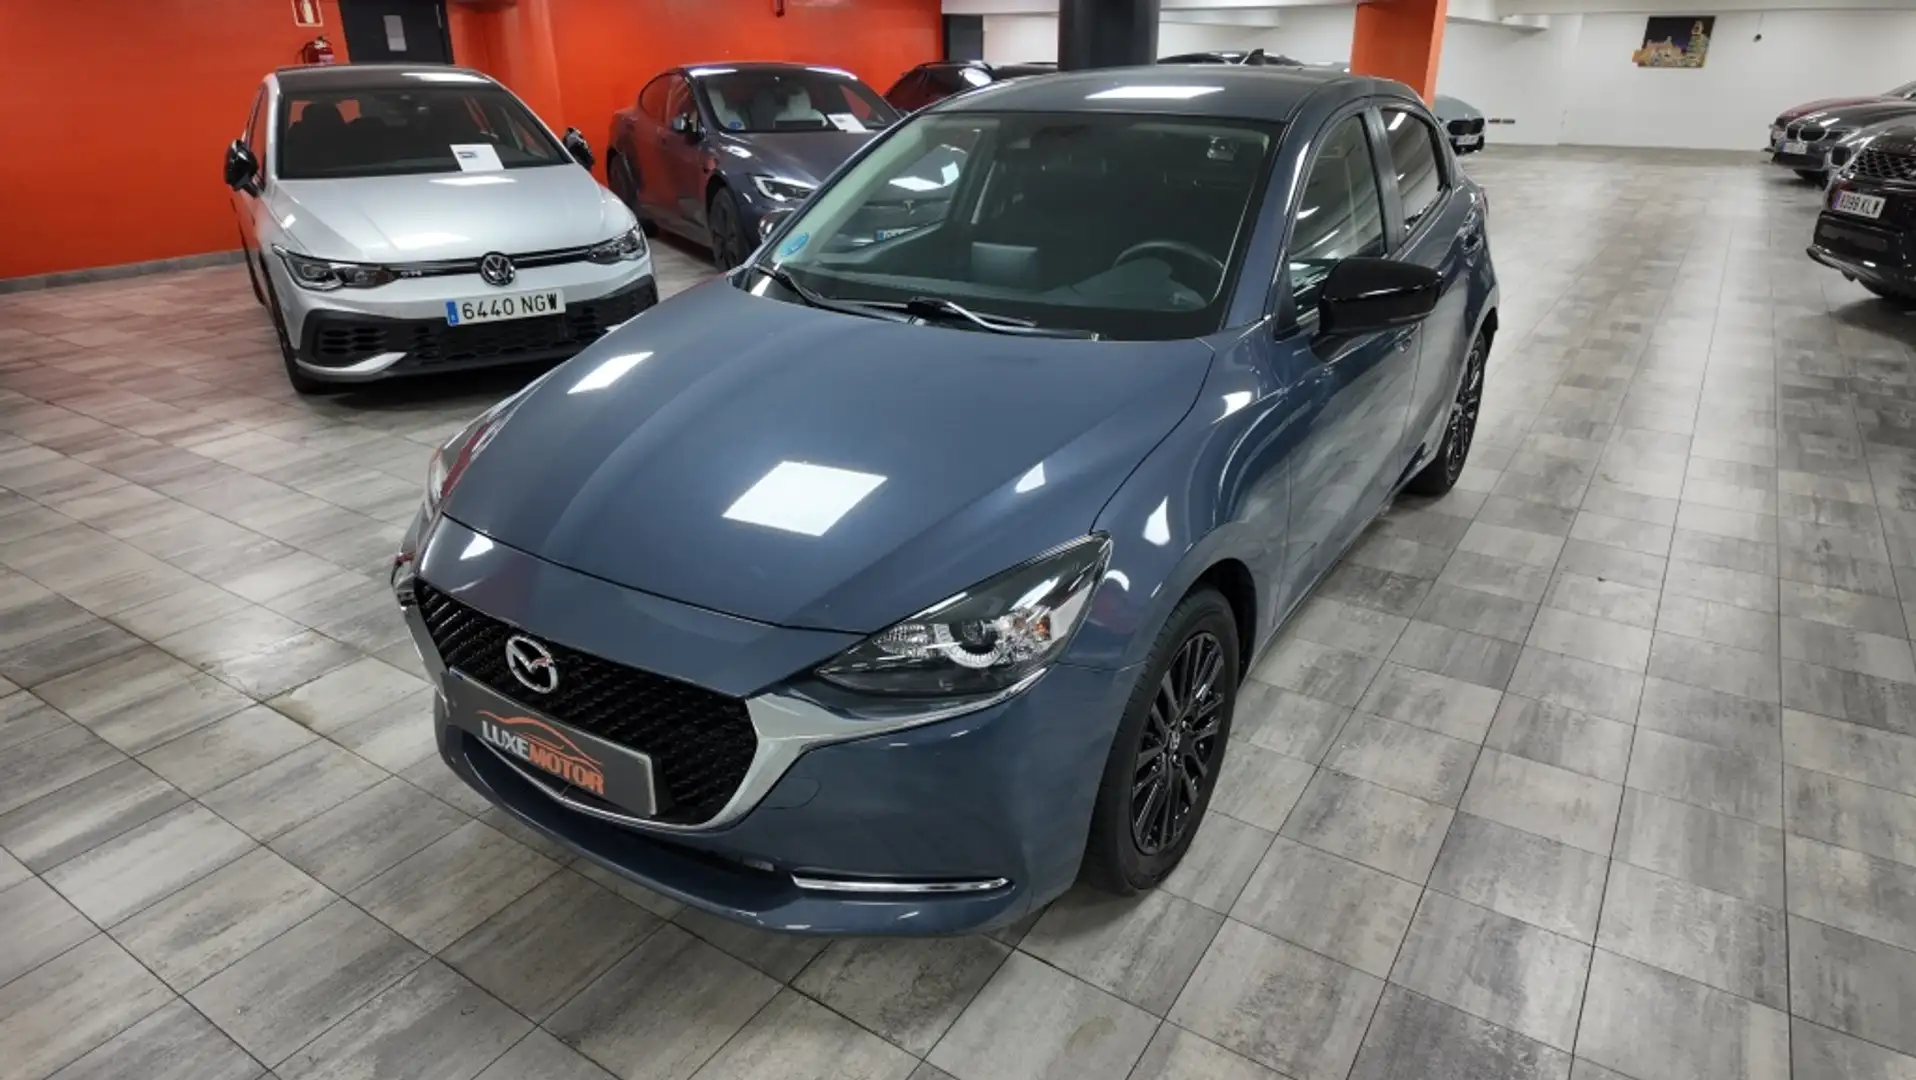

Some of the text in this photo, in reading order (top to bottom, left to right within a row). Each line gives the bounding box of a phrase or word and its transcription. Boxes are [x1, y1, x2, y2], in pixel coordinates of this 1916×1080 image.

[462, 292, 558, 320] 6440 NGW
[481, 719, 605, 795] LUXEMOTOR
